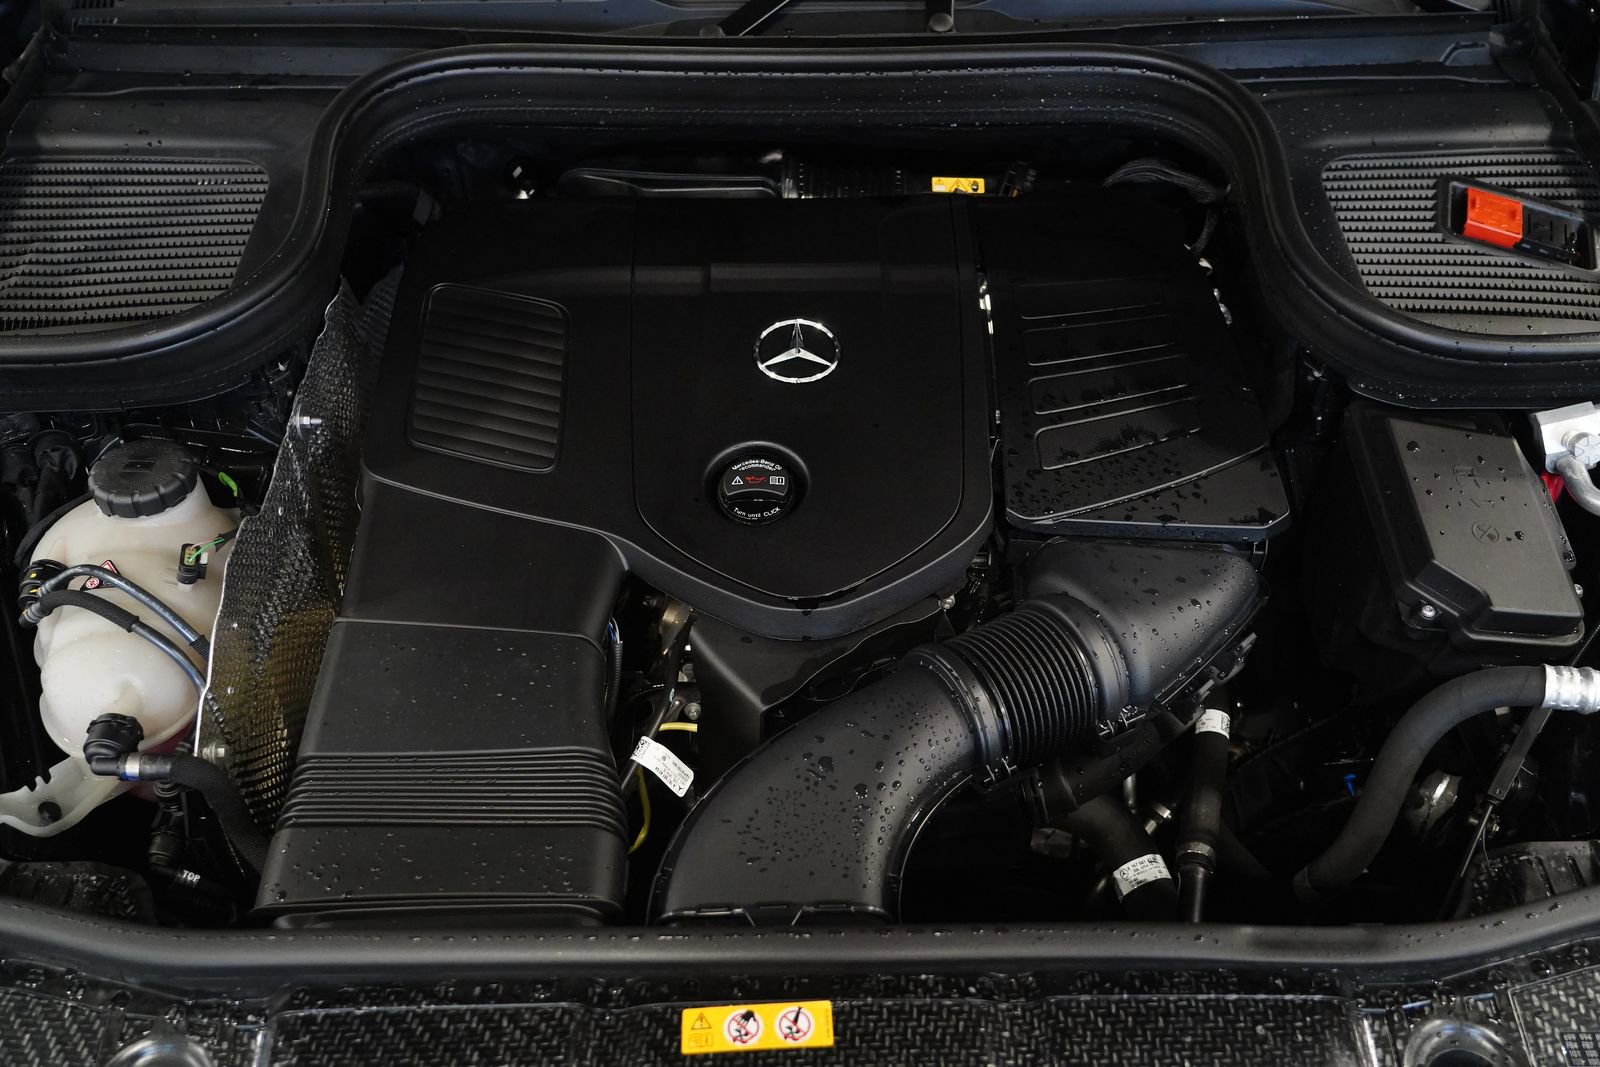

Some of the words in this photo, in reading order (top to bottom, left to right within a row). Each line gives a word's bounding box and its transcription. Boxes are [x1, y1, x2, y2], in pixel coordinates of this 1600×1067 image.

[738, 463, 777, 471] reconde
[733, 507, 746, 516] Turn
[763, 506, 781, 517] CLICK
[182, 869, 201, 882] TOP
